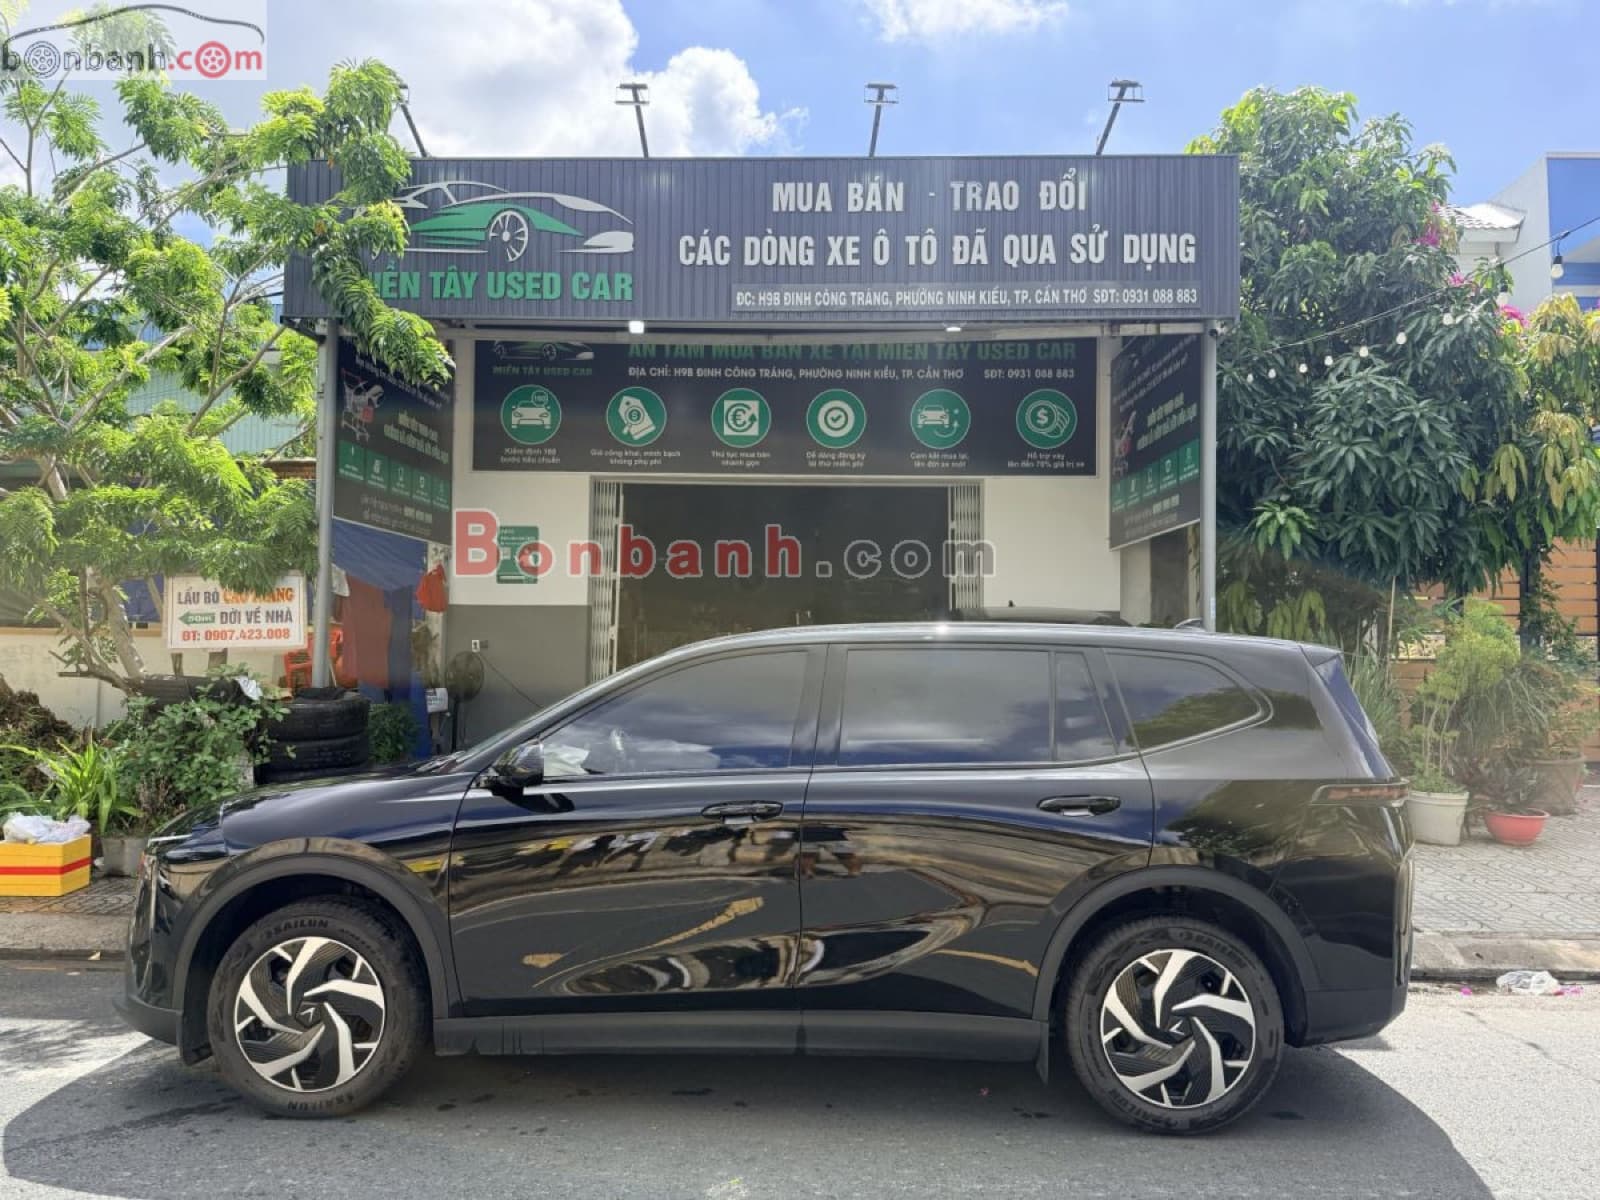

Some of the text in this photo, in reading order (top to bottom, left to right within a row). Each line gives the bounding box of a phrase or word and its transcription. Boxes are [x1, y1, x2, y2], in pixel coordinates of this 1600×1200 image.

[772, 182, 832, 212] MUA
[847, 175, 904, 212] BÁN
[950, 181, 1019, 211] TRAO
[1039, 168, 1087, 211] ĐỔI
[679, 223, 1196, 271] CÁC DÒNG XE Ô TÔ ĐÃ QUA SỬ DỤNG
[429, 265, 478, 300] TÂY
[487, 272, 561, 300] USED
[571, 271, 633, 301] CAR
[758, 291, 781, 306] H9B
[783, 291, 811, 306] ĐINH
[815, 288, 846, 306] CÔNG
[947, 290, 976, 305] NINH
[1014, 289, 1031, 304] TP.
[1063, 286, 1087, 304] THƠ
[1122, 288, 1148, 303] 0931
[1152, 288, 1173, 303] 088
[1176, 287, 1197, 303] 883
[976, 342, 1029, 361] USED
[1037, 341, 1076, 361] CAR
[628, 366, 647, 380] ĐỊA
[674, 367, 693, 377] H9B
[724, 365, 756, 378] CÔNG
[846, 367, 871, 378] NINH
[902, 367, 914, 378] TP.
[1007, 368, 1031, 379] 0931
[265, 607, 293, 624] NHÀ
[204, 627, 291, 641] 0907.423.008
